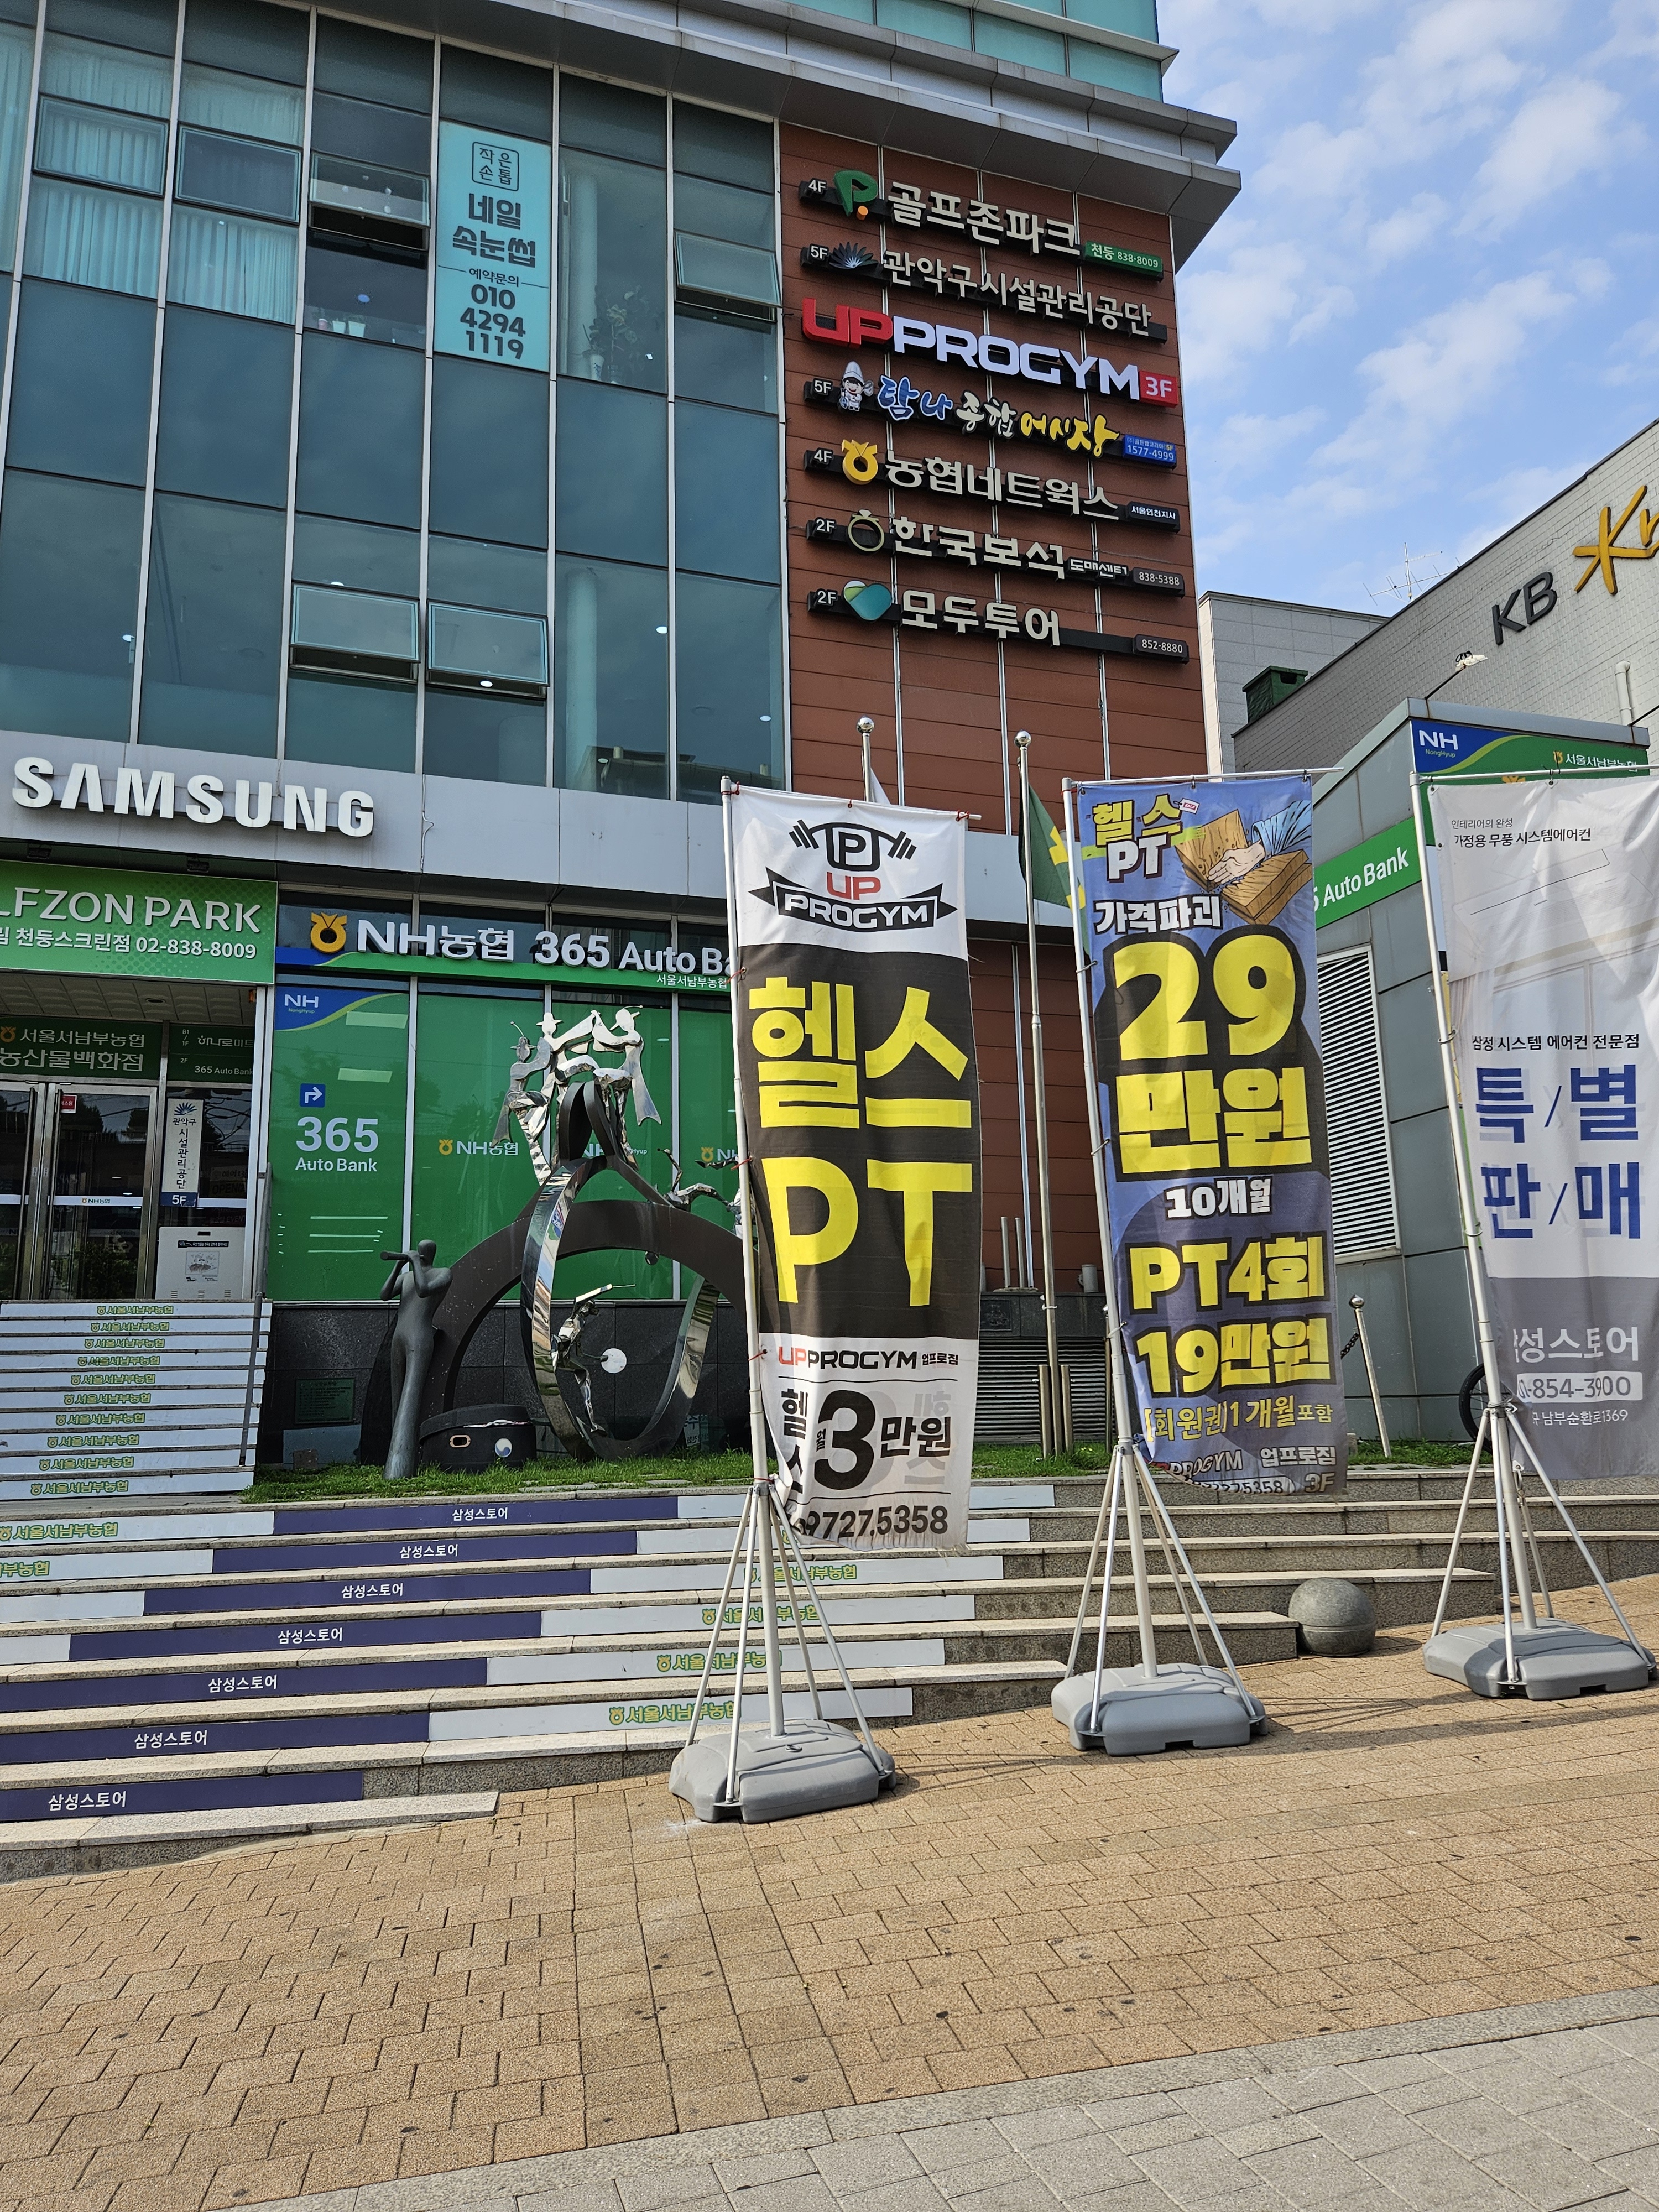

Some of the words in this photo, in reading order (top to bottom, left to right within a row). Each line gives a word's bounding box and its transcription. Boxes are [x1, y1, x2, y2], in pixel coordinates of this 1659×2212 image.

[808, 178, 827, 193] 4F
[468, 193, 521, 230] 네일
[888, 181, 1081, 256] 골프존파크
[452, 225, 536, 268] 속눈썹
[810, 246, 828, 260] 5F
[1091, 243, 1114, 260] 천둥
[1117, 252, 1159, 268] 838-8009
[469, 268, 519, 287] 예약문의
[471, 284, 515, 310] 010
[460, 307, 526, 337] 4294
[466, 330, 524, 360] 1119
[814, 379, 832, 394] 5F
[1145, 376, 1172, 398] 3F
[813, 448, 832, 464] 4F
[1127, 445, 1174, 461] 1577-4999
[885, 450, 1119, 520] 농협네트웍스
[1131, 505, 1176, 520] 서울인천지사
[815, 519, 836, 533] 2F
[893, 516, 1065, 580] 한국보석
[1070, 558, 1128, 578] 도매센터
[1139, 571, 1180, 586] 838-5388
[816, 591, 837, 605] 2F
[1491, 571, 1558, 645] KB
[901, 589, 1060, 647] 모두투어
[1141, 638, 1183, 654] 852-8880
[1418, 729, 1459, 752] NH
[1425, 748, 1456, 758] NongHyup
[12, 757, 375, 838] SAMSUNG
[1451, 818, 1494, 829] 인테리어의
[1495, 817, 1514, 828] 완성
[1454, 833, 1487, 848] 가정용
[1488, 833, 1514, 847] 무풍
[1516, 828, 1591, 845] 시스템에어컨
[1107, 836, 1167, 880] PT
[826, 871, 881, 901] UP
[1323, 875, 1361, 907] Auto
[1363, 847, 1410, 887] Bank
[144, 896, 262, 934] PARK
[784, 895, 928, 929] PROGYM
[1094, 895, 1221, 933] 가격파괴
[15, 927, 131, 953] 천둥스크린점
[136, 937, 257, 959] 02-838-8009
[358, 919, 515, 963] NH농협
[534, 930, 611, 969] 365
[618, 942, 696, 975] Auto
[656, 974, 727, 989] 서울서남부농협
[284, 993, 319, 1009] NH
[1113, 934, 1296, 1061] 29
[19, 1029, 145, 1048] 서울서남부농협
[1472, 1036, 1494, 1051] 삼성
[1498, 1035, 1542, 1051] 시스템
[1547, 1035, 1588, 1050] 에어컨
[1593, 1034, 1640, 1050] 전문점
[749, 976, 972, 1129] 헬스
[194, 1065, 213, 1074] 365
[173, 1117, 197, 1126] 관악구
[1116, 1067, 1312, 1174] 만원
[295, 1115, 379, 1154] 365
[176, 1128, 189, 1190] 시설관리공단
[295, 1157, 333, 1172] Auto
[337, 1157, 378, 1172] Bank
[171, 1194, 187, 1205] 5F
[1166, 1178, 1271, 1218] 10개월
[761, 1157, 973, 1307] PT
[921, 1352, 959, 1366] 업프로짐
[1136, 1318, 1331, 1394] 19만원
[74, 1393, 151, 1405] 서울서남부농협
[66, 1413, 145, 1425] 서울서남부농협
[59, 1434, 140, 1447] 서울서남부농협
[51, 1456, 134, 1470] 서울서남부농협
[1259, 1446, 1337, 1468] 업프로짐
[42, 1480, 129, 1495] 서울서남부농협
[1304, 1472, 1336, 1494] 3F
[452, 1505, 508, 1521] 삼성스토어
[13, 1522, 118, 1541] 서울서남부농협
[399, 1543, 458, 1560] 삼성스토어
[341, 1582, 404, 1599] 삼성스토어
[277, 1626, 343, 1645] 삼성스토어
[208, 1674, 278, 1693] 삼성스토어
[134, 1729, 208, 1750] 삼성스토어
[48, 1790, 127, 1812] 삼성스토어
